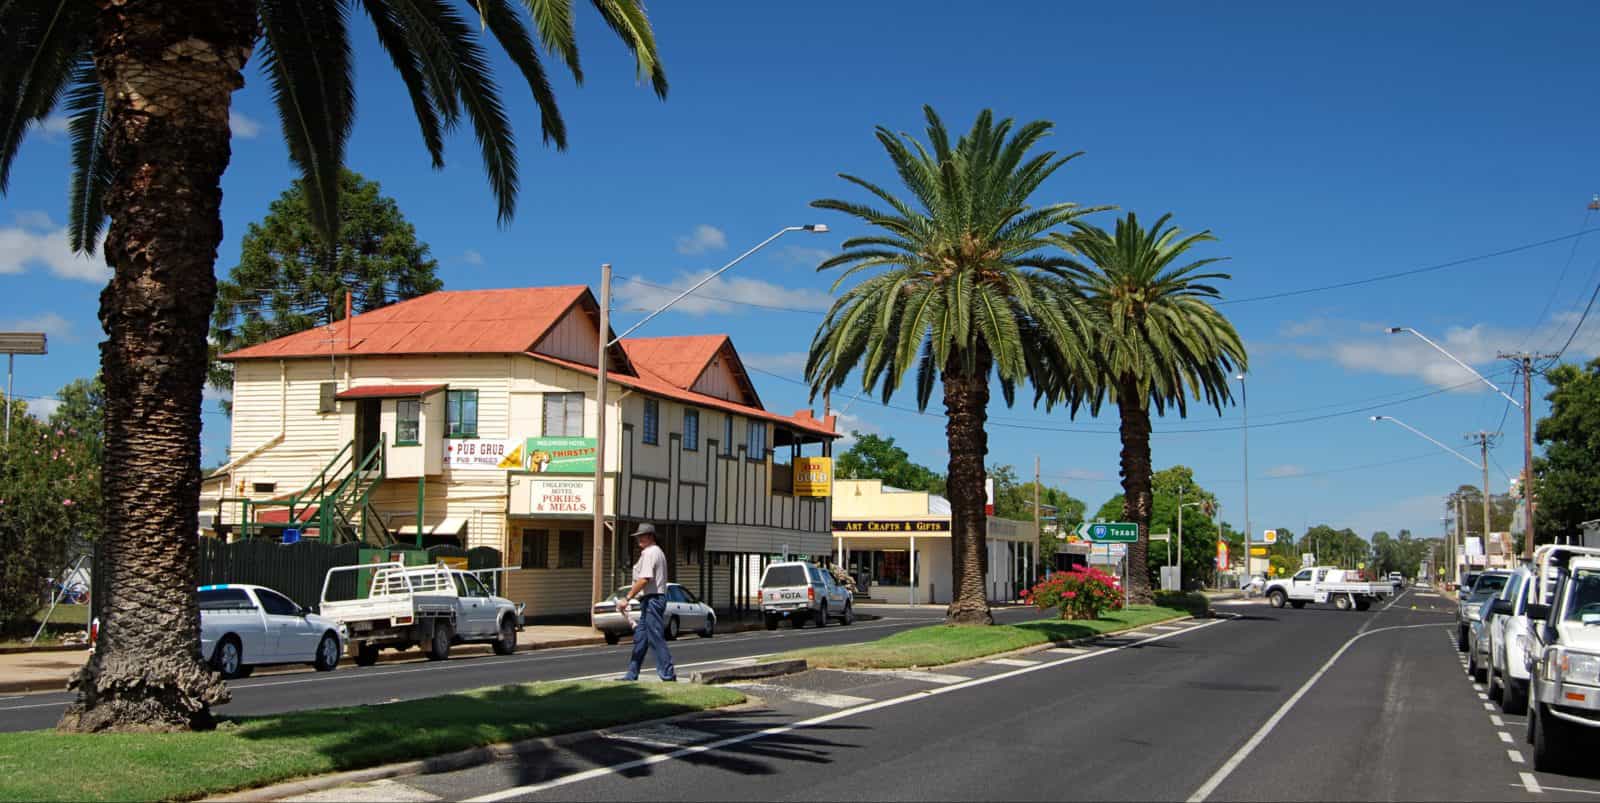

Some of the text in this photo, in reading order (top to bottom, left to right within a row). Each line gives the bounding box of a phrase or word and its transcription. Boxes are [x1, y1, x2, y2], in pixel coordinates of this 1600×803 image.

[457, 443, 505, 456] PUB GRUB
[797, 471, 827, 482] GOLD
[542, 495, 582, 503] POKIES
[536, 503, 587, 511] & MEALS
[905, 522, 911, 530] &
[1110, 528, 1136, 536] Texas
[768, 591, 801, 600] TYOTA
